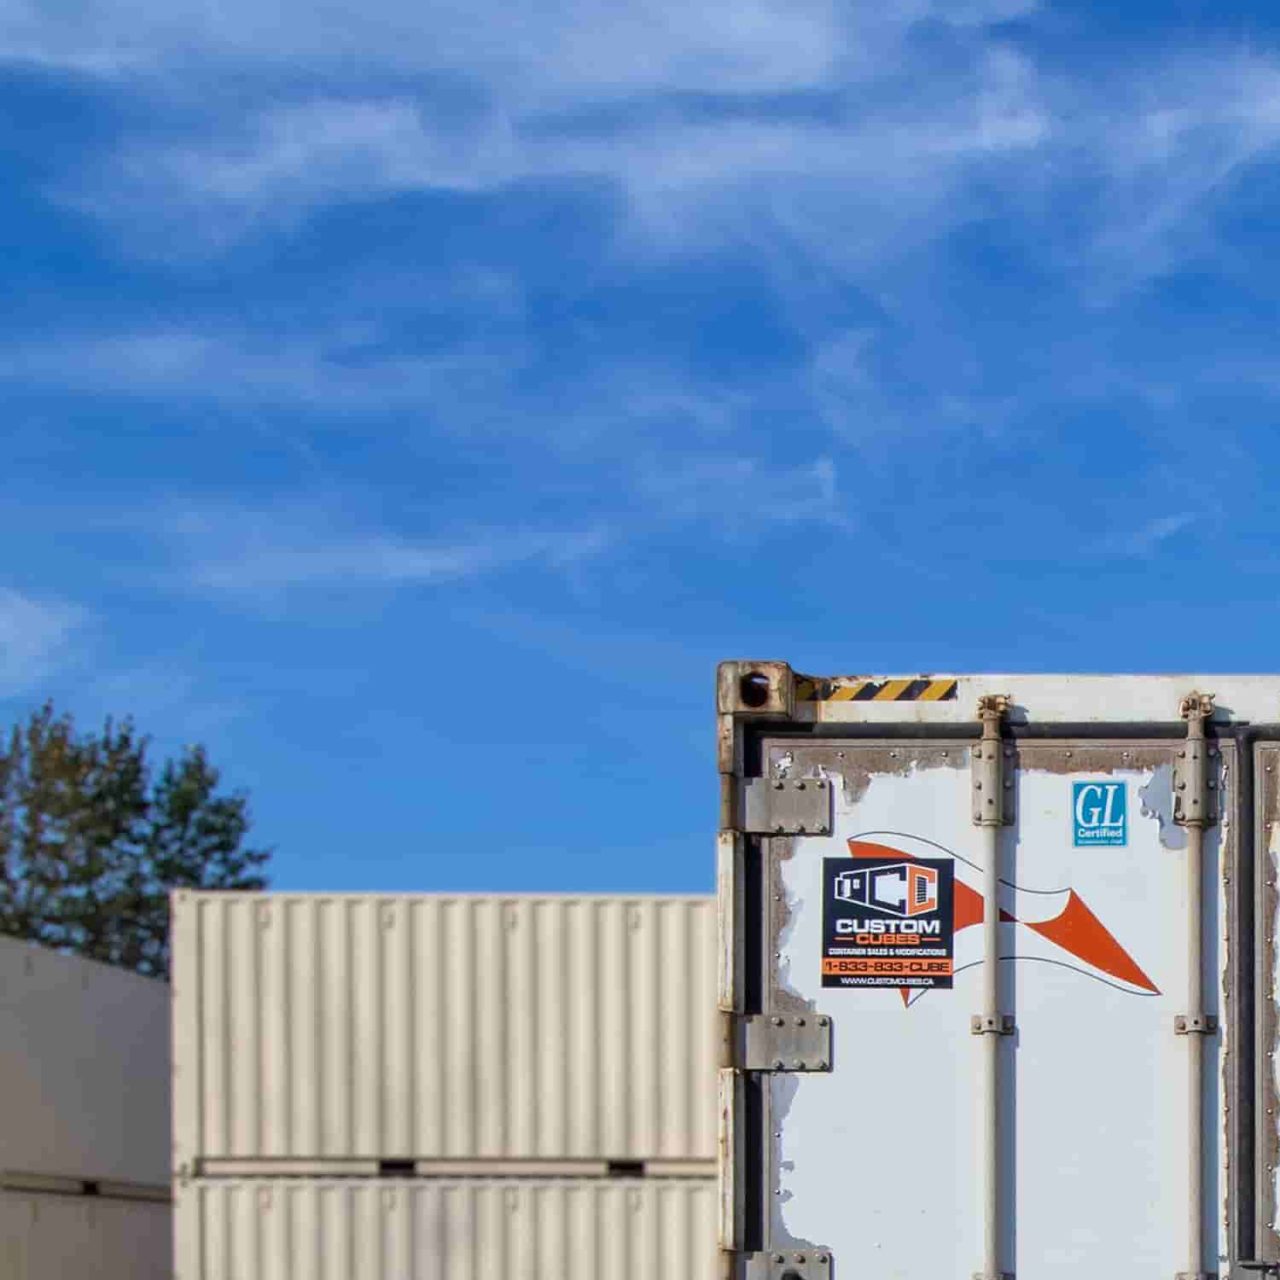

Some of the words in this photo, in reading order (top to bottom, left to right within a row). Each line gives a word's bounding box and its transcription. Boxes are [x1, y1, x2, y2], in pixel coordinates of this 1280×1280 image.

[1076, 784, 1124, 828] GL
[1078, 828, 1123, 838] Certified
[835, 918, 941, 934] CUSTOM
[855, 933, 921, 945] CUBES
[867, 948, 888, 956] SALES
[825, 960, 950, 973] 1-833-833-CUBE
